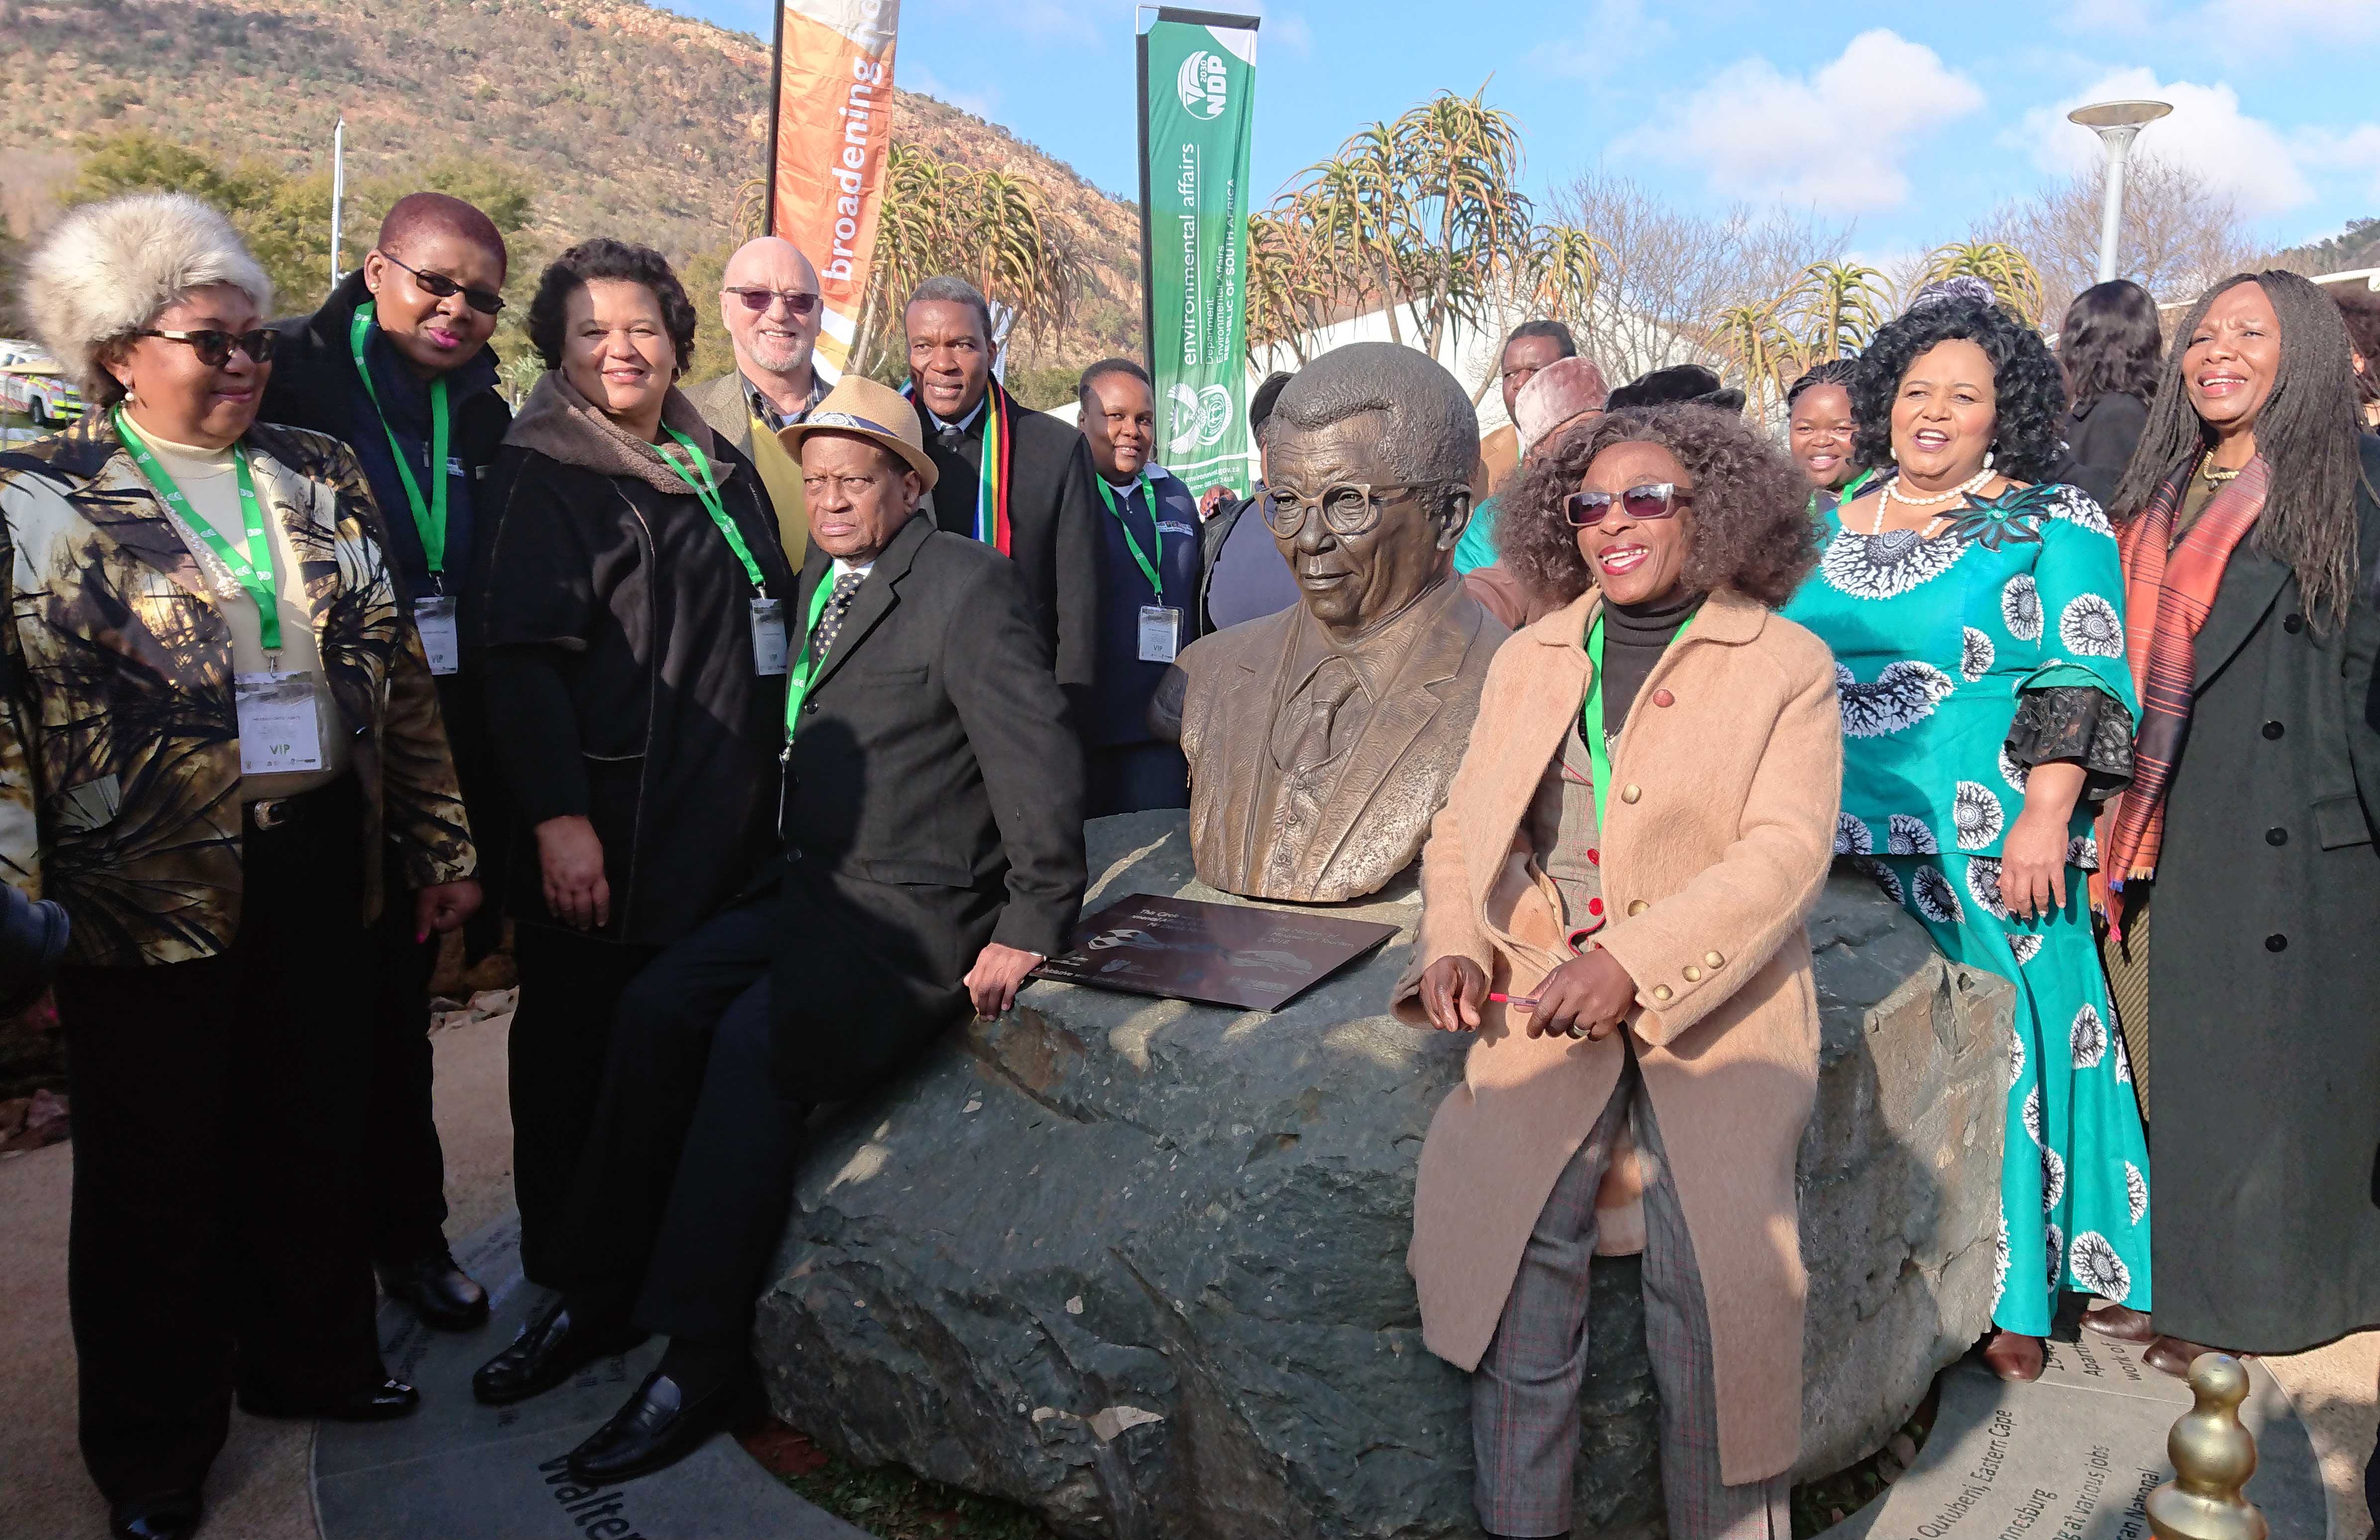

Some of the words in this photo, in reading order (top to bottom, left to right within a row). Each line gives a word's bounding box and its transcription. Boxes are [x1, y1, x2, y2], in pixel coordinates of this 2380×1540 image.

[1207, 55, 1227, 114] NDP
[822, 56, 883, 282] broadening
[1178, 143, 1194, 207] affairs
[1216, 245, 1225, 282] Affairs
[1225, 231, 1235, 276] SOUTH
[1178, 215, 1196, 366] environmental
[1226, 277, 1234, 296] OF
[1205, 296, 1215, 365] Department:
[1224, 299, 1233, 362] REPUBLIC
[269, 744, 291, 755] VIP
[2100, 1342, 2125, 1353] of
[2111, 1356, 2143, 1381] work
[1988, 1410, 2017, 1438] Cape
[1970, 1439, 2008, 1483] Eastern
[2083, 1444, 2112, 1473] jobs
[2072, 1471, 2105, 1515] various
[2064, 1515, 2086, 1531] at
